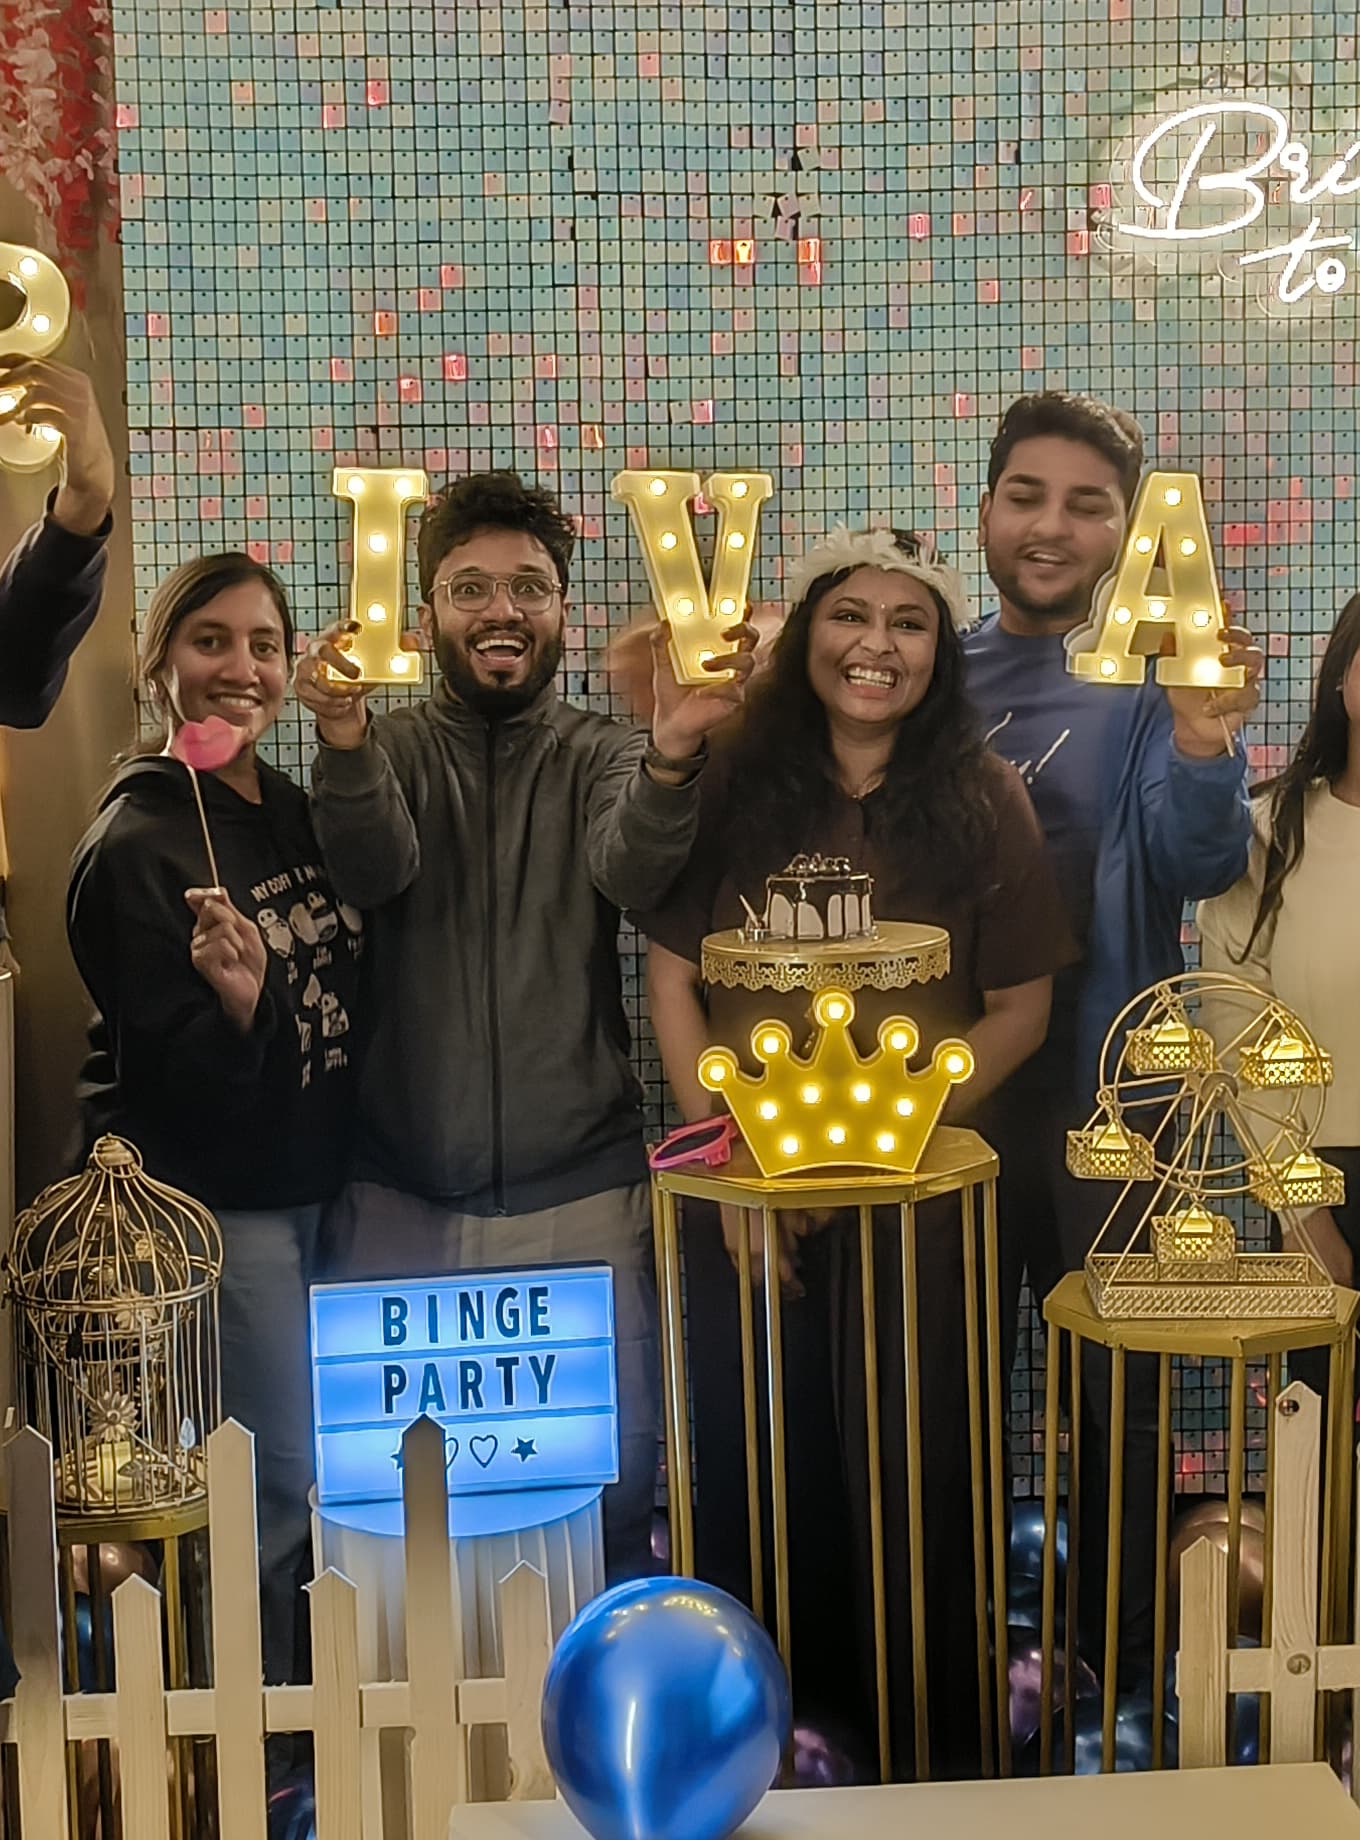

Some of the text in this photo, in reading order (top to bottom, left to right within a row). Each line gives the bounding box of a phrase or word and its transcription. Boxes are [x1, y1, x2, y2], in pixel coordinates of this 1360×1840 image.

[1239, 217, 1353, 303] to
[328, 467, 428, 685] I
[611, 469, 773, 685] V
[1066, 472, 1247, 688] A
[381, 1286, 551, 1346] BINGE
[383, 1354, 556, 1414] PARTY
